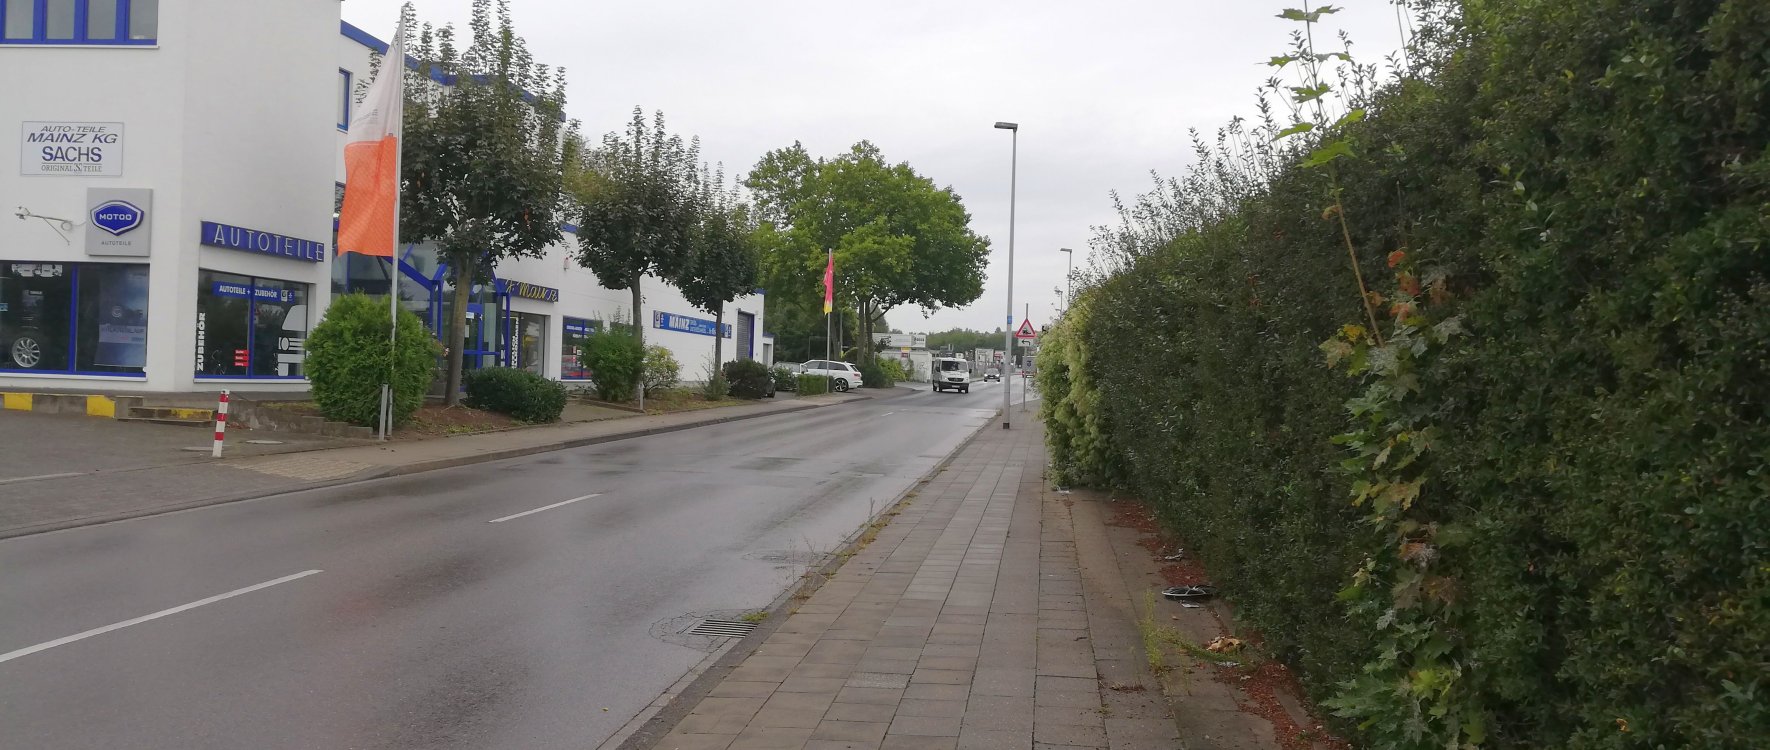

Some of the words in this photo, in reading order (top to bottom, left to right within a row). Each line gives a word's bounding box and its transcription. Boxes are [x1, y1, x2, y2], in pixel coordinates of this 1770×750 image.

[27, 132, 87, 143] MAINZ
[92, 133, 118, 144] KG
[41, 145, 102, 162] SACHS
[41, 164, 73, 172] ORIGINAL
[214, 224, 324, 261] AUTOTEILE
[219, 285, 246, 295] AUTOTEILE
[254, 288, 278, 298] ZUBEHÖR
[668, 315, 690, 331] MAINZ
[197, 312, 206, 371] ZUBEHÖR
